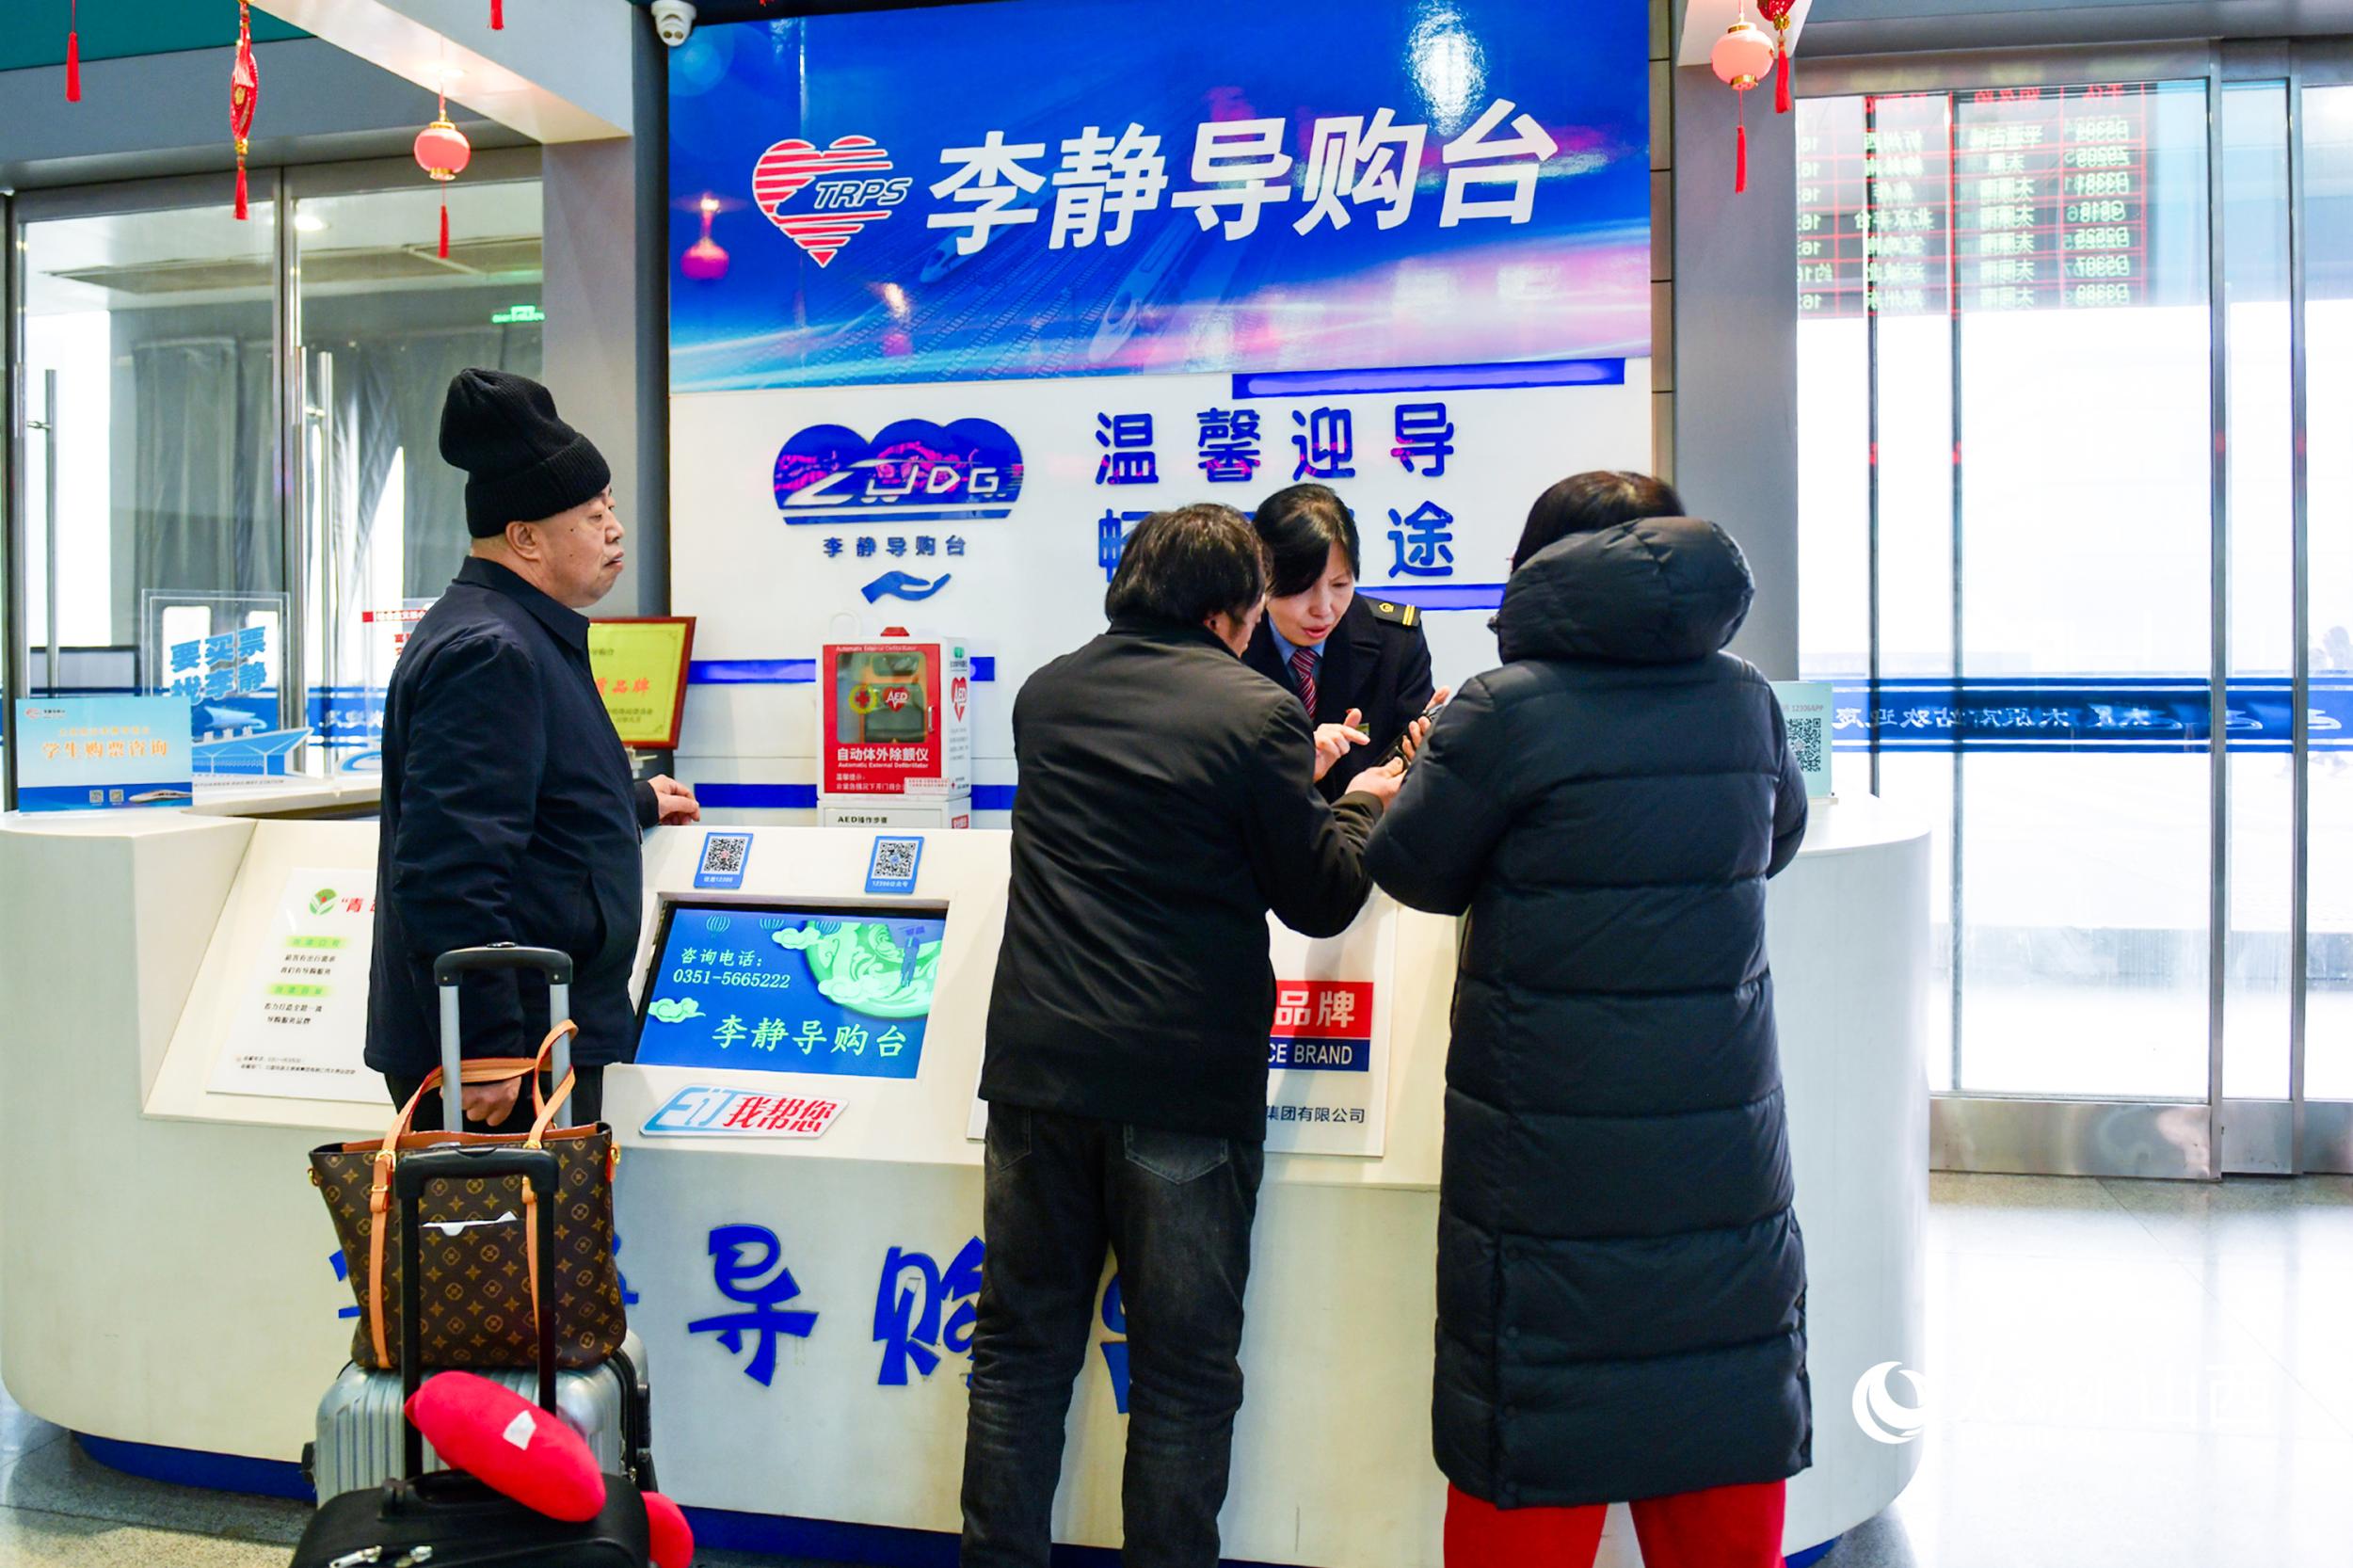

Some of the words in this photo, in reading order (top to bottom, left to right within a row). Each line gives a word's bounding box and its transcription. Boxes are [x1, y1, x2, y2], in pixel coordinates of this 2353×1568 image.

[812, 177, 912, 209] TRPS
[926, 99, 1559, 256] 李静导购台
[1095, 402, 1455, 488] 温馨迎导
[823, 535, 966, 558] 李静导购台
[170, 625, 266, 674] 要买票
[170, 661, 267, 706] 找李静
[886, 690, 909, 704] AED
[42, 740, 169, 759] 学生购票咨询
[837, 747, 930, 761] 自动体外除颤仪
[673, 968, 792, 989] 0351-5665222
[1274, 990, 1355, 1028] 品牌
[712, 1014, 907, 1058] 李静导购台
[1294, 1044, 1353, 1064] BRAND
[723, 1096, 838, 1132] 我帮您
[1267, 1105, 1365, 1124] 集团有限公司
